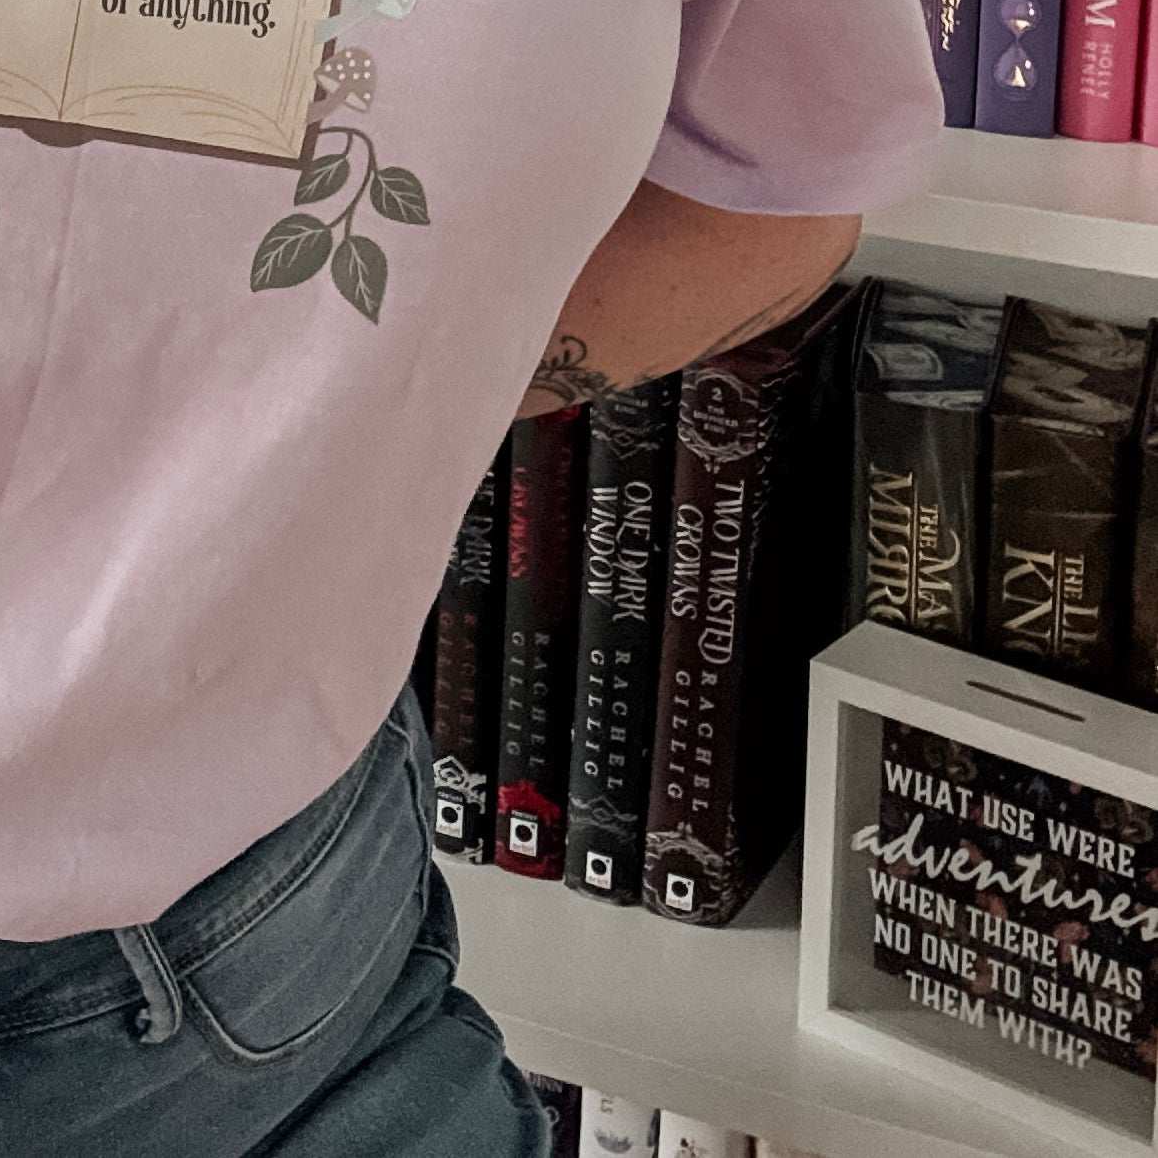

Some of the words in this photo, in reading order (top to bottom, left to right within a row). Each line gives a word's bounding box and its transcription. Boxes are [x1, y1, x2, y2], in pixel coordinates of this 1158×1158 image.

[1097, 43, 1115, 100] HOLLY
[711, 387, 723, 402] 2
[586, 486, 619, 599] WINDOW
[615, 481, 653, 541] ONE
[670, 503, 705, 620] CROWNS
[713, 478, 745, 543] TWO
[919, 504, 939, 549] THE
[611, 548, 650, 622] DARK
[697, 546, 740, 665] TWISTED
[1064, 554, 1085, 600] THE
[505, 631, 525, 756] GILLIG
[529, 632, 550, 768] RACHEL
[583, 649, 605, 777] GILLIG
[607, 649, 633, 789] RACHEL
[667, 669, 691, 800] GILLIG
[691, 670, 718, 812] RACHEL
[884, 760, 973, 819] WHAT
[983, 795, 1035, 843] USE
[1046, 818, 1136, 879] WERE
[867, 868, 957, 929] WHEN
[966, 904, 1059, 967] THERE
[1069, 944, 1143, 1001] WAS
[873, 914, 911, 955] NO
[921, 932, 978, 981] ONE
[987, 958, 1022, 999] TO
[1032, 975, 1133, 1043] SHARE
[906, 970, 987, 1029] THEM
[996, 1006, 1092, 1070] WITH?
